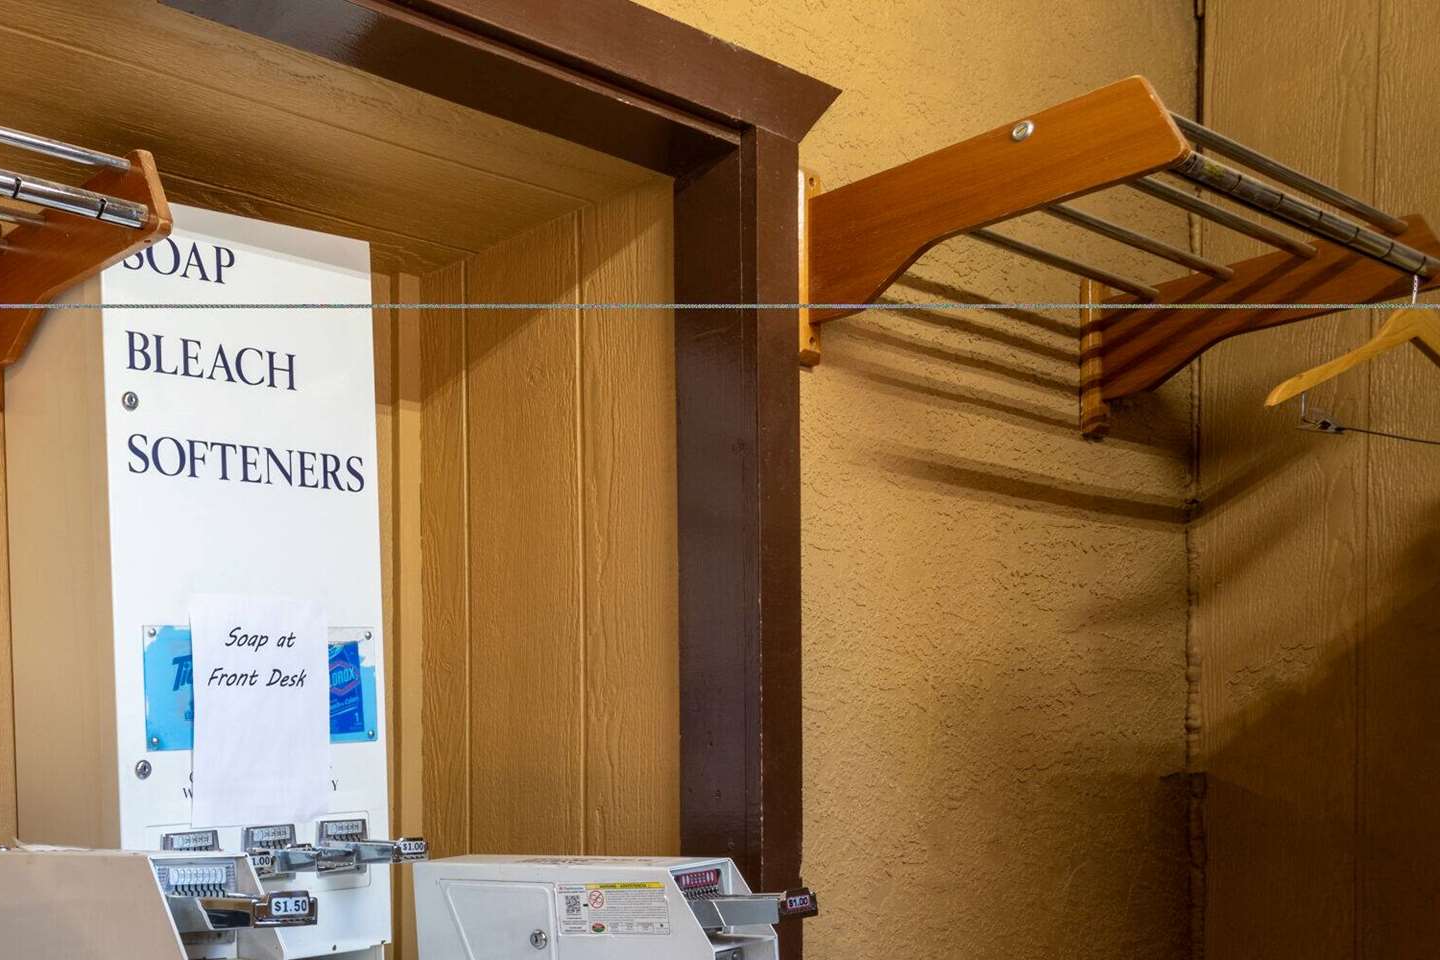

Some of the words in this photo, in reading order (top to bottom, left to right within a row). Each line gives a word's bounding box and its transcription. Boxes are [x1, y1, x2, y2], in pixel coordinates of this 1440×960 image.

[124, 330, 297, 391] BLEACH
[127, 433, 365, 493] SOFTENERS
[225, 626, 269, 652] Soap
[277, 632, 296, 648] at
[207, 667, 259, 686] Front
[265, 668, 307, 687] Desk
[402, 842, 424, 851] $1.00
[251, 855, 271, 866] 1.00
[274, 899, 307, 913] $1.50
[788, 896, 809, 908] $1.00
